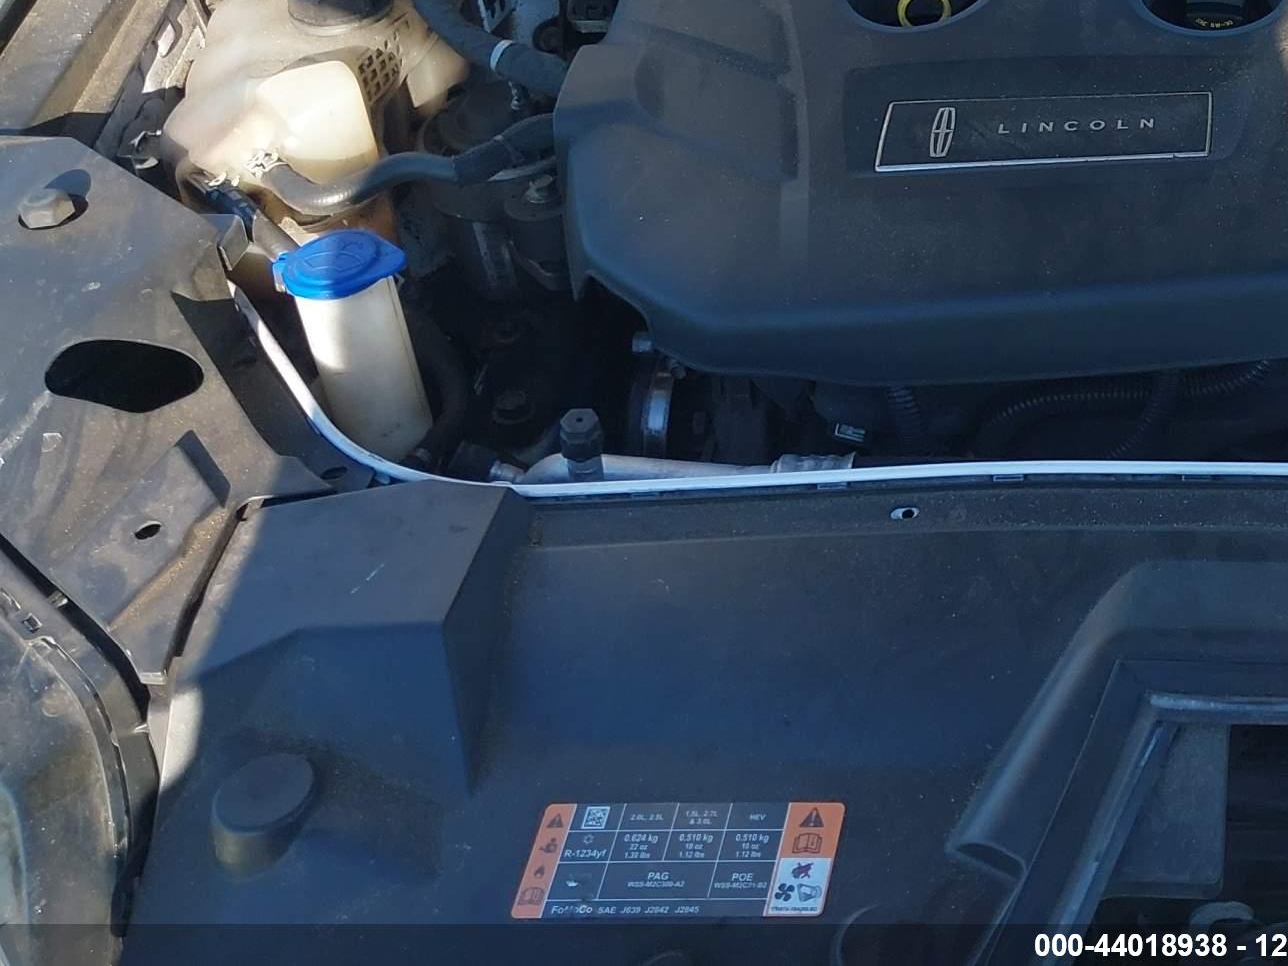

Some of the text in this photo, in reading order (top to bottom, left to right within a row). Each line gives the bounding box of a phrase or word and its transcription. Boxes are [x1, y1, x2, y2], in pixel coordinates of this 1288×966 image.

[997, 117, 1155, 134] LINCOLN
[749, 813, 767, 821] HEV
[648, 833, 658, 844] kg
[679, 833, 714, 844] 0.510 kg
[735, 833, 770, 844] 0.510 kg
[564, 849, 607, 859] R-1234yf
[647, 871, 669, 880] PAG
[731, 873, 753, 881] POE
[598, 906, 617, 914] SAE
